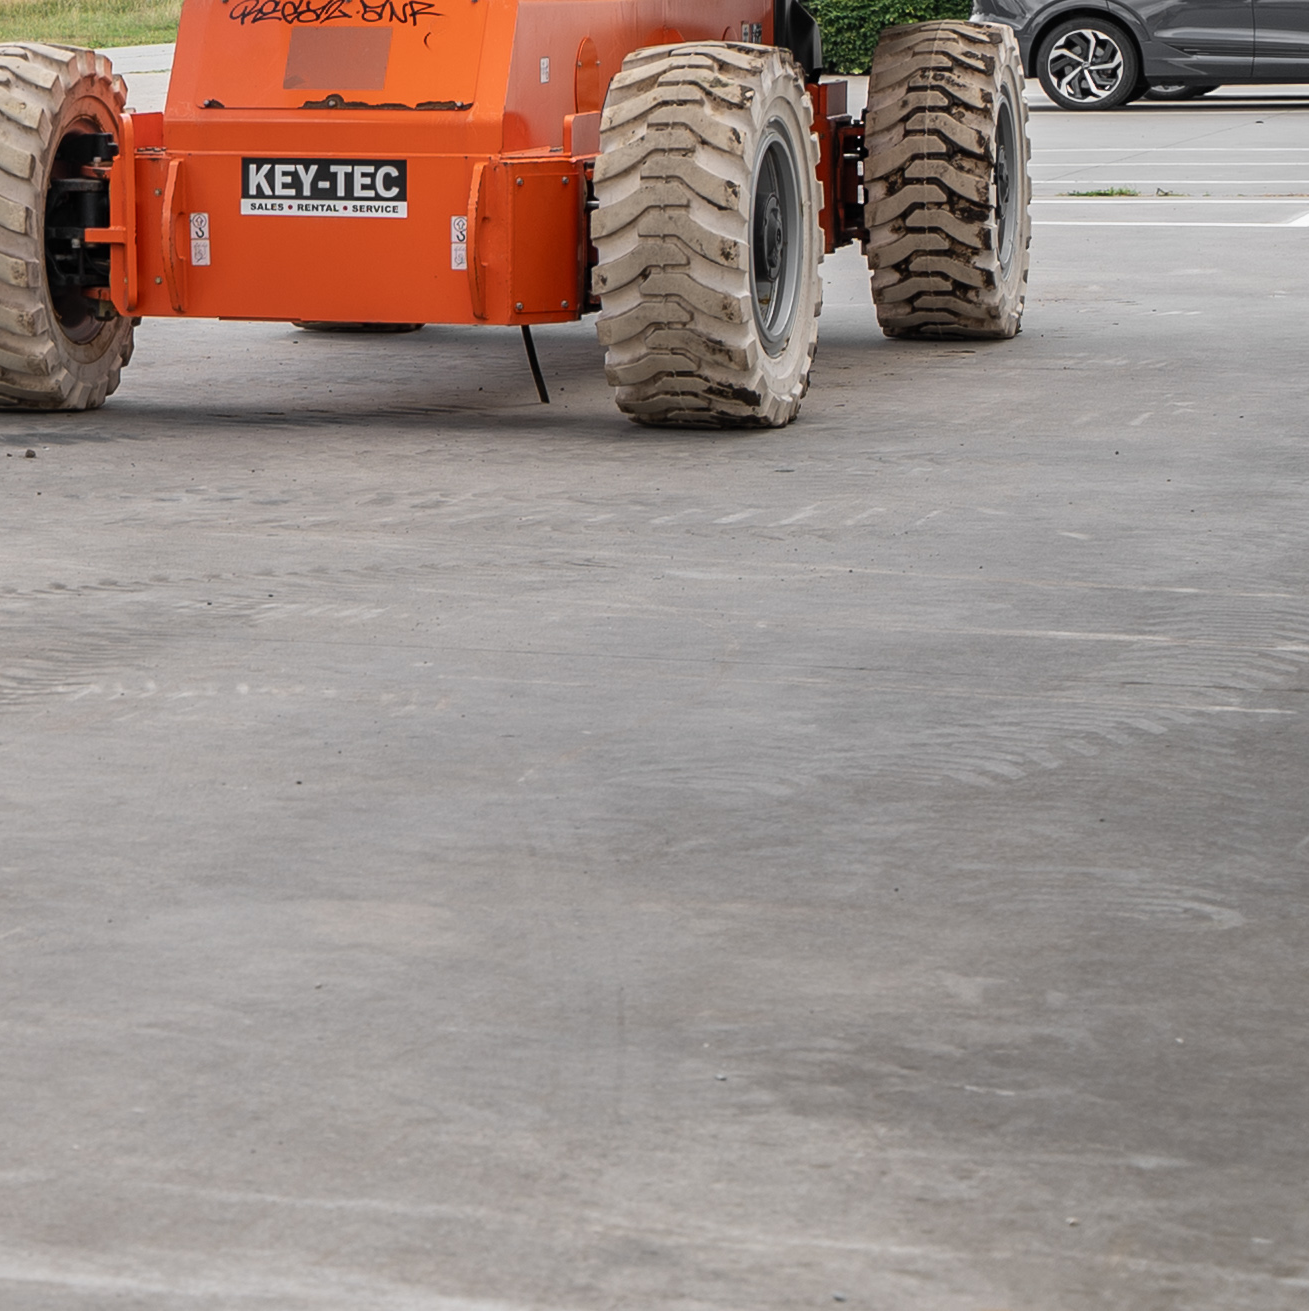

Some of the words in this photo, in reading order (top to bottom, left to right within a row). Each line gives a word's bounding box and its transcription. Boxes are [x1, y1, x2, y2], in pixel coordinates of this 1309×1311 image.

[248, 164, 400, 198] KEY-TEC
[250, 203, 284, 211] SALES
[297, 204, 339, 212] RENTAL
[352, 205, 399, 213] SERVICE
